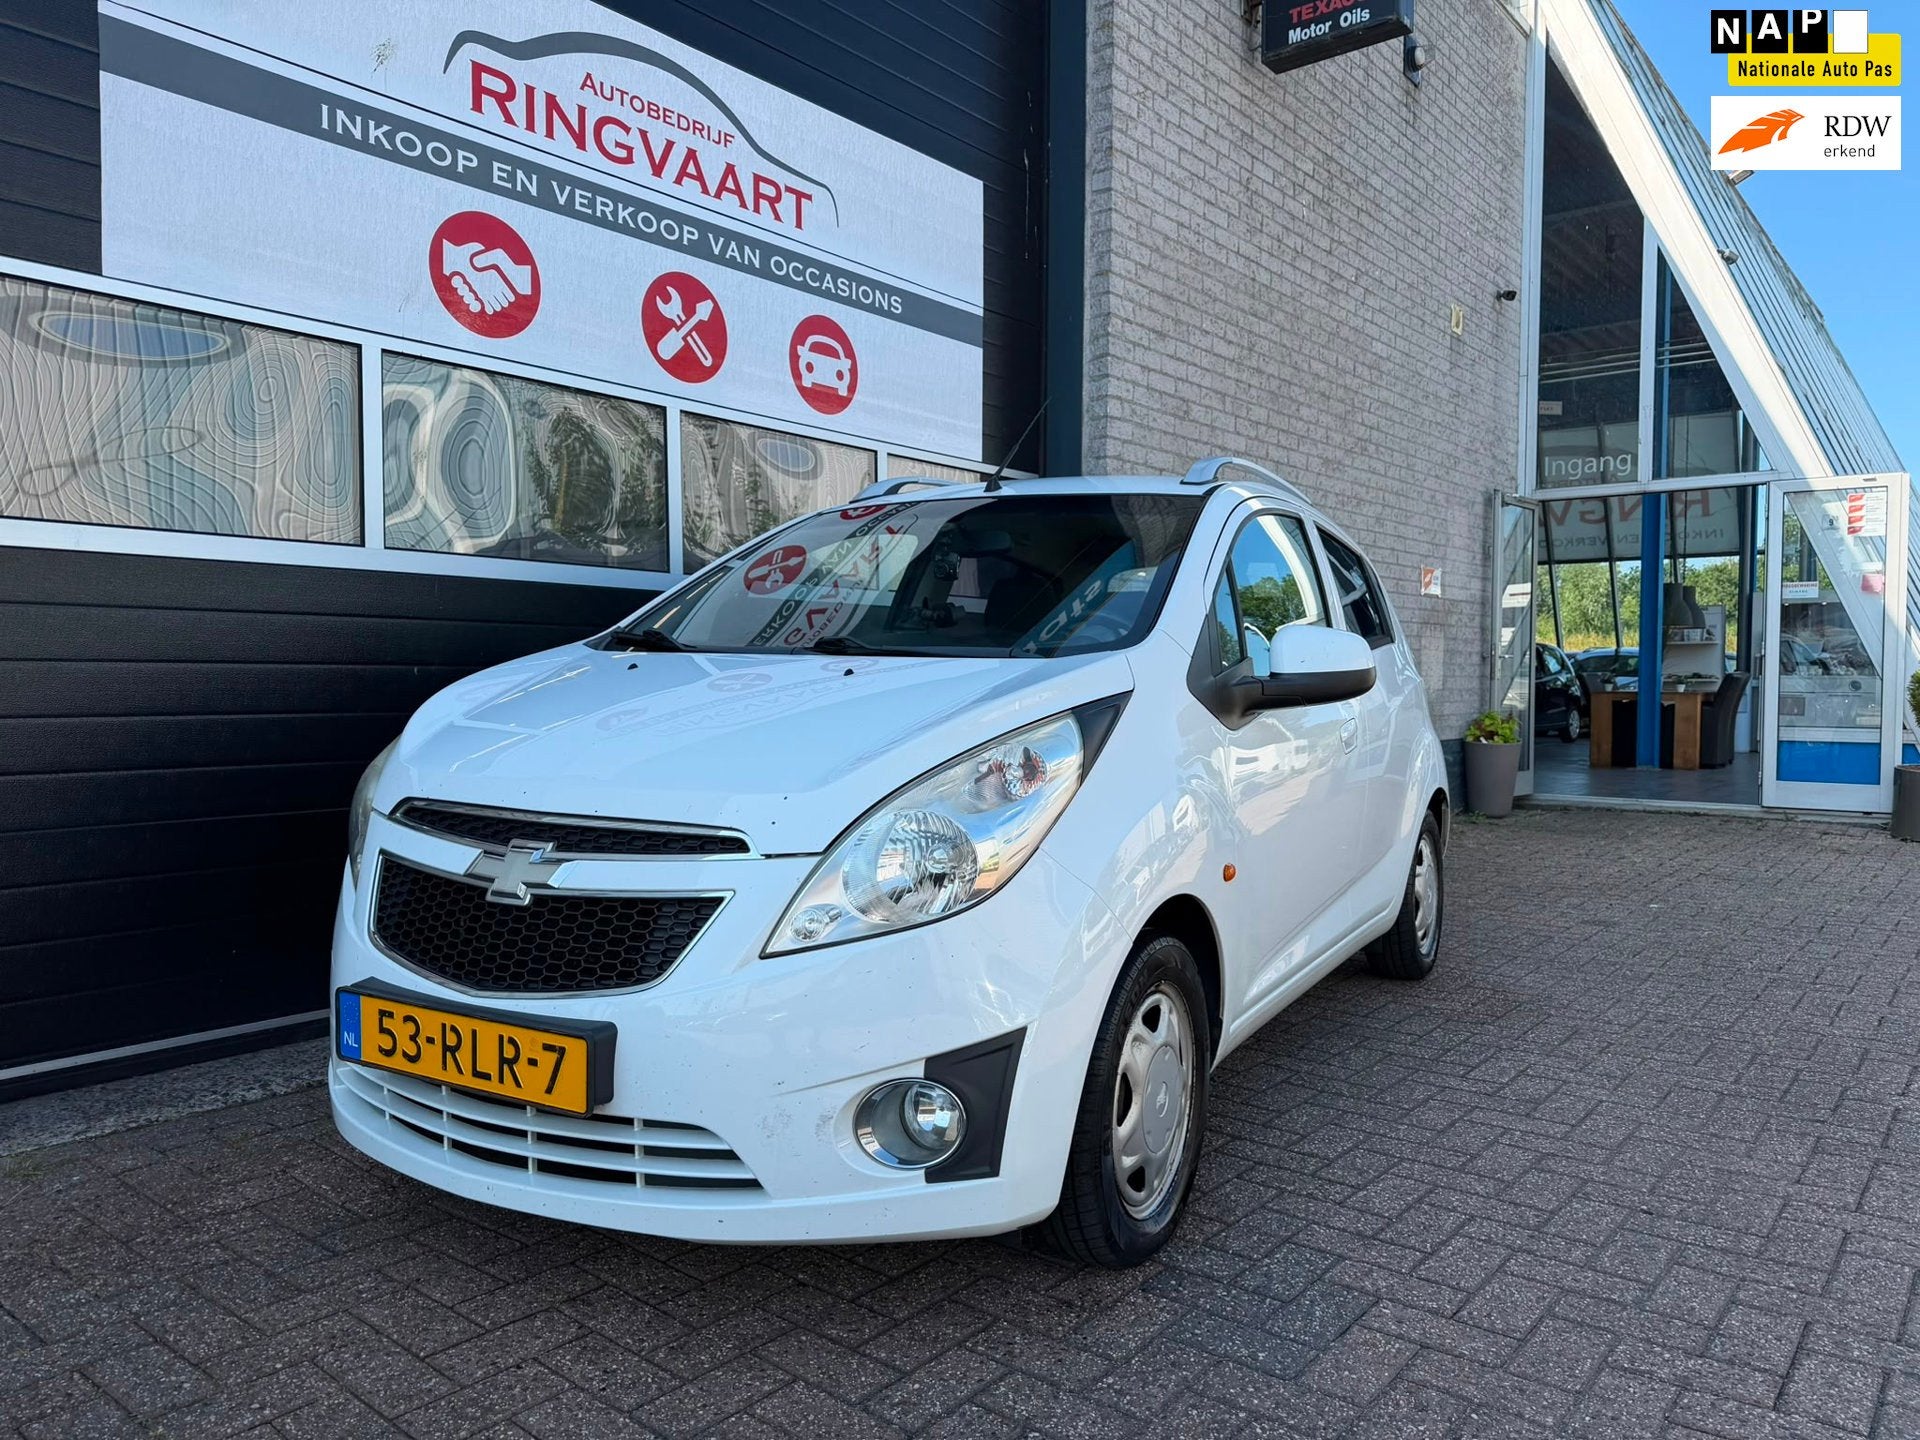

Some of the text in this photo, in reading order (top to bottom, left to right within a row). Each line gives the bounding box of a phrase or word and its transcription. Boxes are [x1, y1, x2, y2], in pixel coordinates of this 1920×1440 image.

[1288, 7, 1371, 45] Motor Oils
[1289, 0, 1365, 24] TEXA
[579, 71, 735, 149] AUTOBEDRIJF
[469, 58, 812, 231] RINGVAART
[320, 103, 903, 314] INKOOP EN VERKOOP VAN OCCASIONS
[1544, 453, 1632, 480] Ingang
[343, 1031, 359, 1048] NL
[377, 1008, 568, 1096] 53-RLR-7
